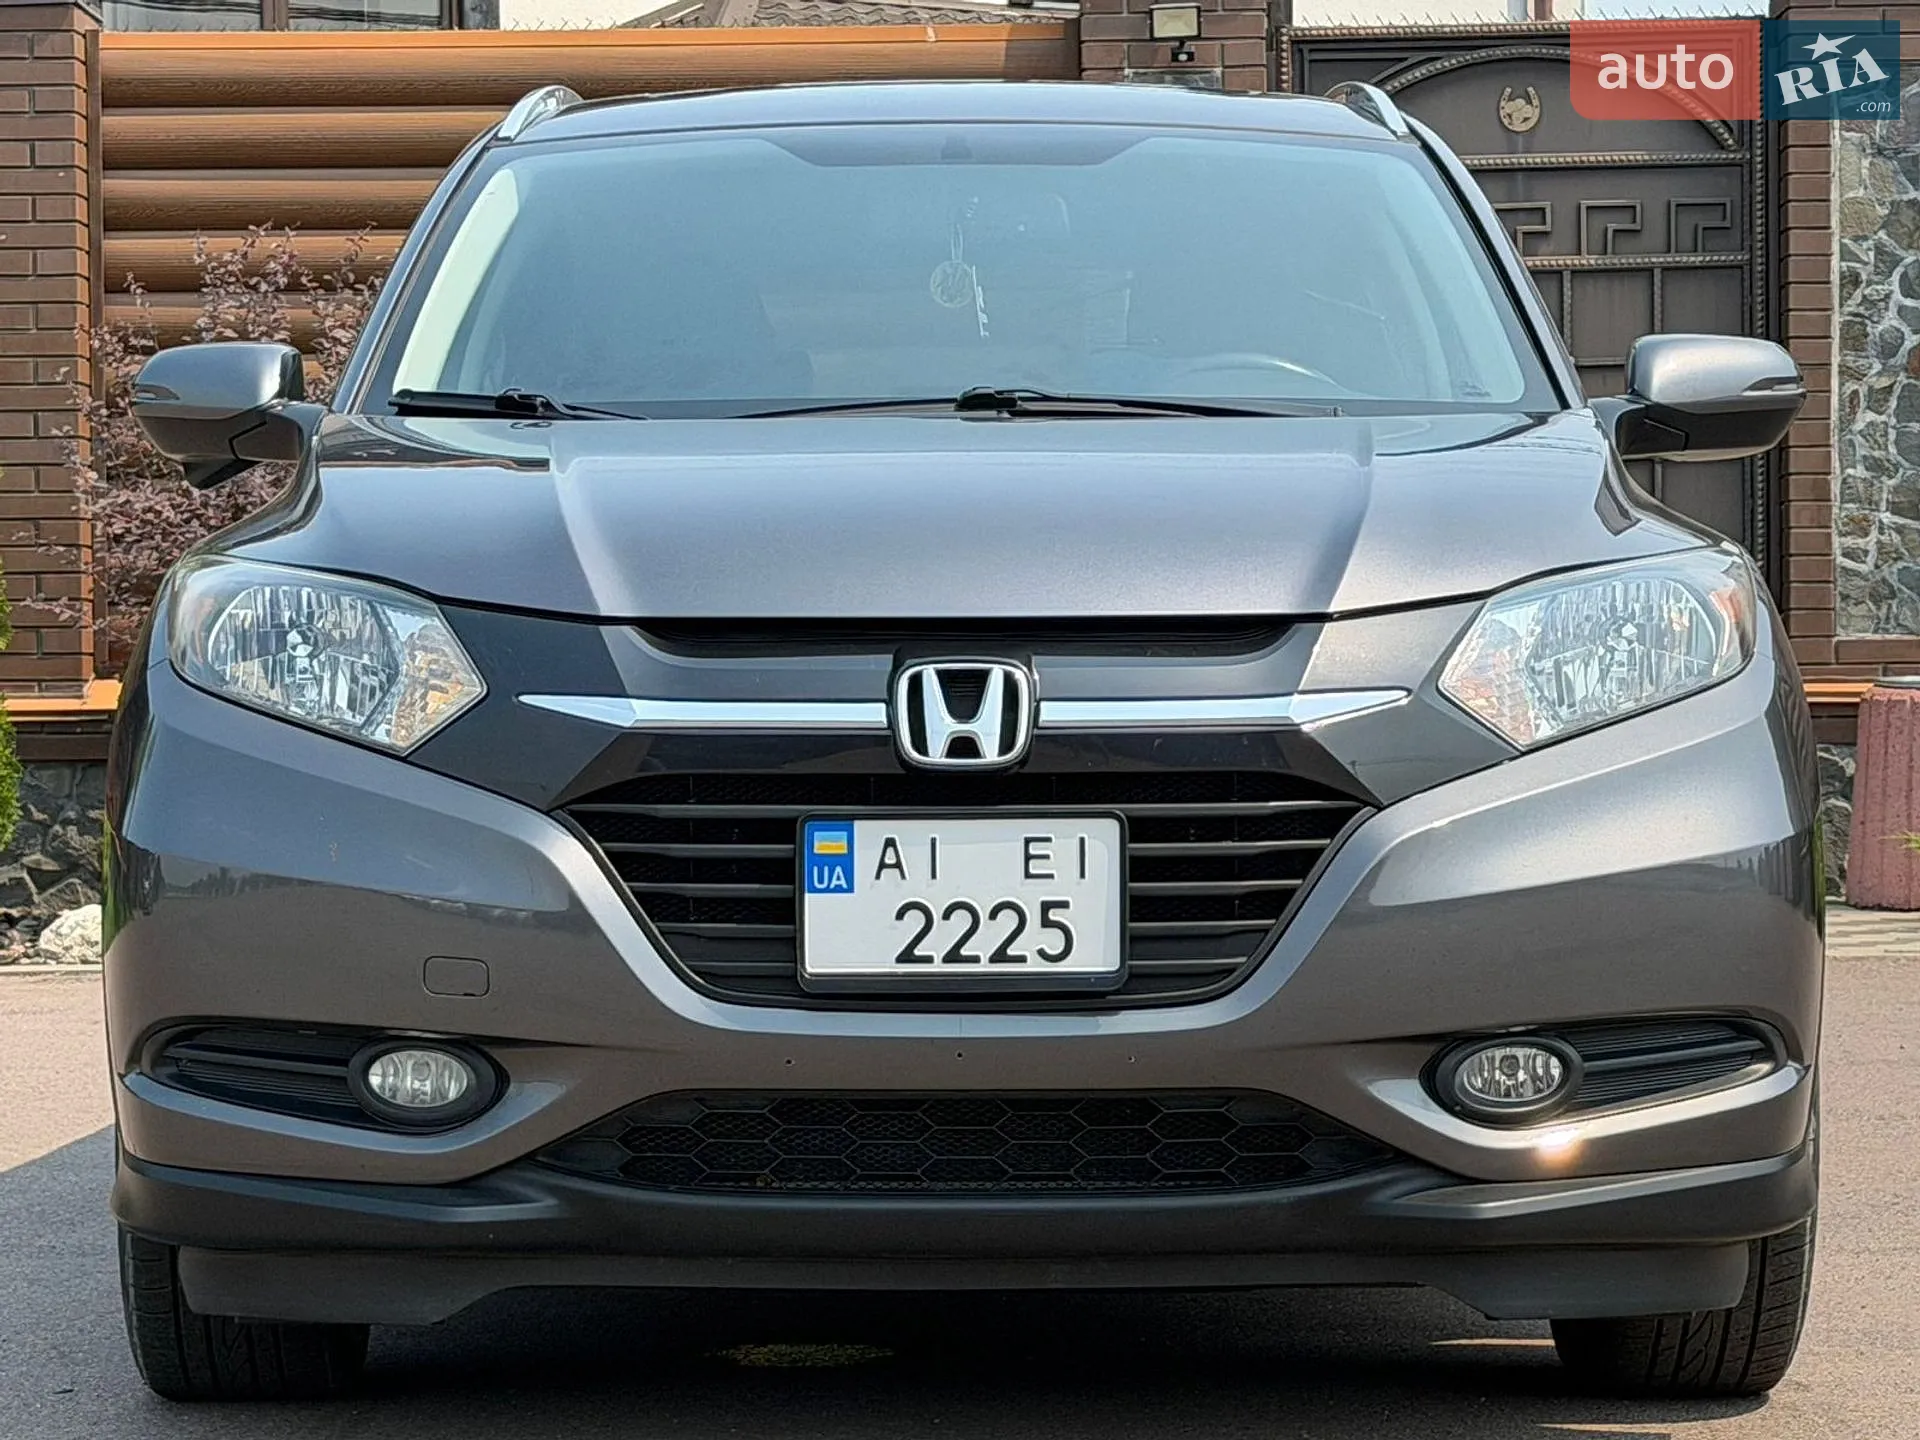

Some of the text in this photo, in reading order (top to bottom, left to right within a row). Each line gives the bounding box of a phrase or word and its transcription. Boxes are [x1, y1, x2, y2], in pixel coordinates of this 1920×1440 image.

[812, 865, 848, 889] UA
[874, 835, 1087, 881] AI EI
[894, 899, 1075, 964] 2225
